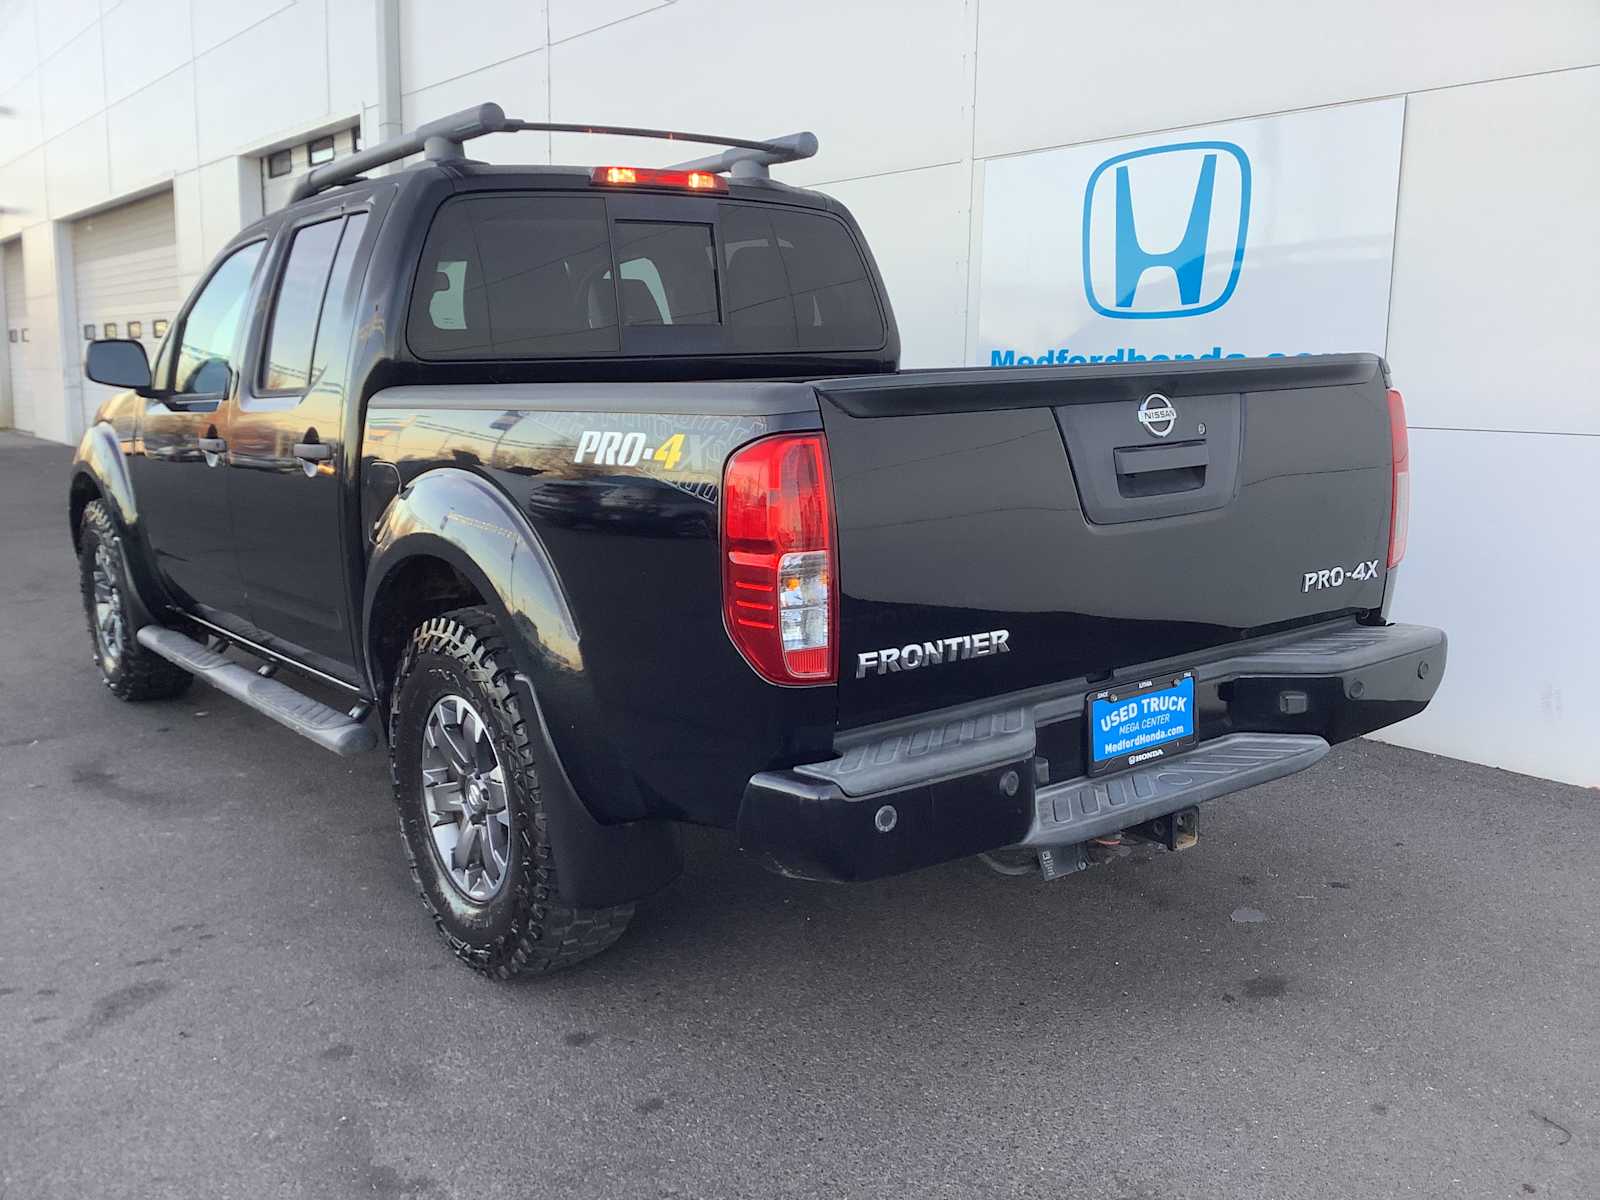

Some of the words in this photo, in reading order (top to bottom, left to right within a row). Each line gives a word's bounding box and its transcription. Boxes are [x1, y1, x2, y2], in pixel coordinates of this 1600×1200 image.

[1144, 409, 1175, 420] NISSAN
[1303, 559, 1379, 593] PRO-4X
[855, 629, 1010, 679] FRONTIER
[1100, 702, 1138, 732] USED
[1141, 695, 1187, 713] TRUCK
[1118, 723, 1140, 736] MEGA
[1141, 713, 1170, 730] CENTER
[1104, 725, 1184, 755] MedfordHonda.com
[1136, 748, 1164, 763] HONDA
